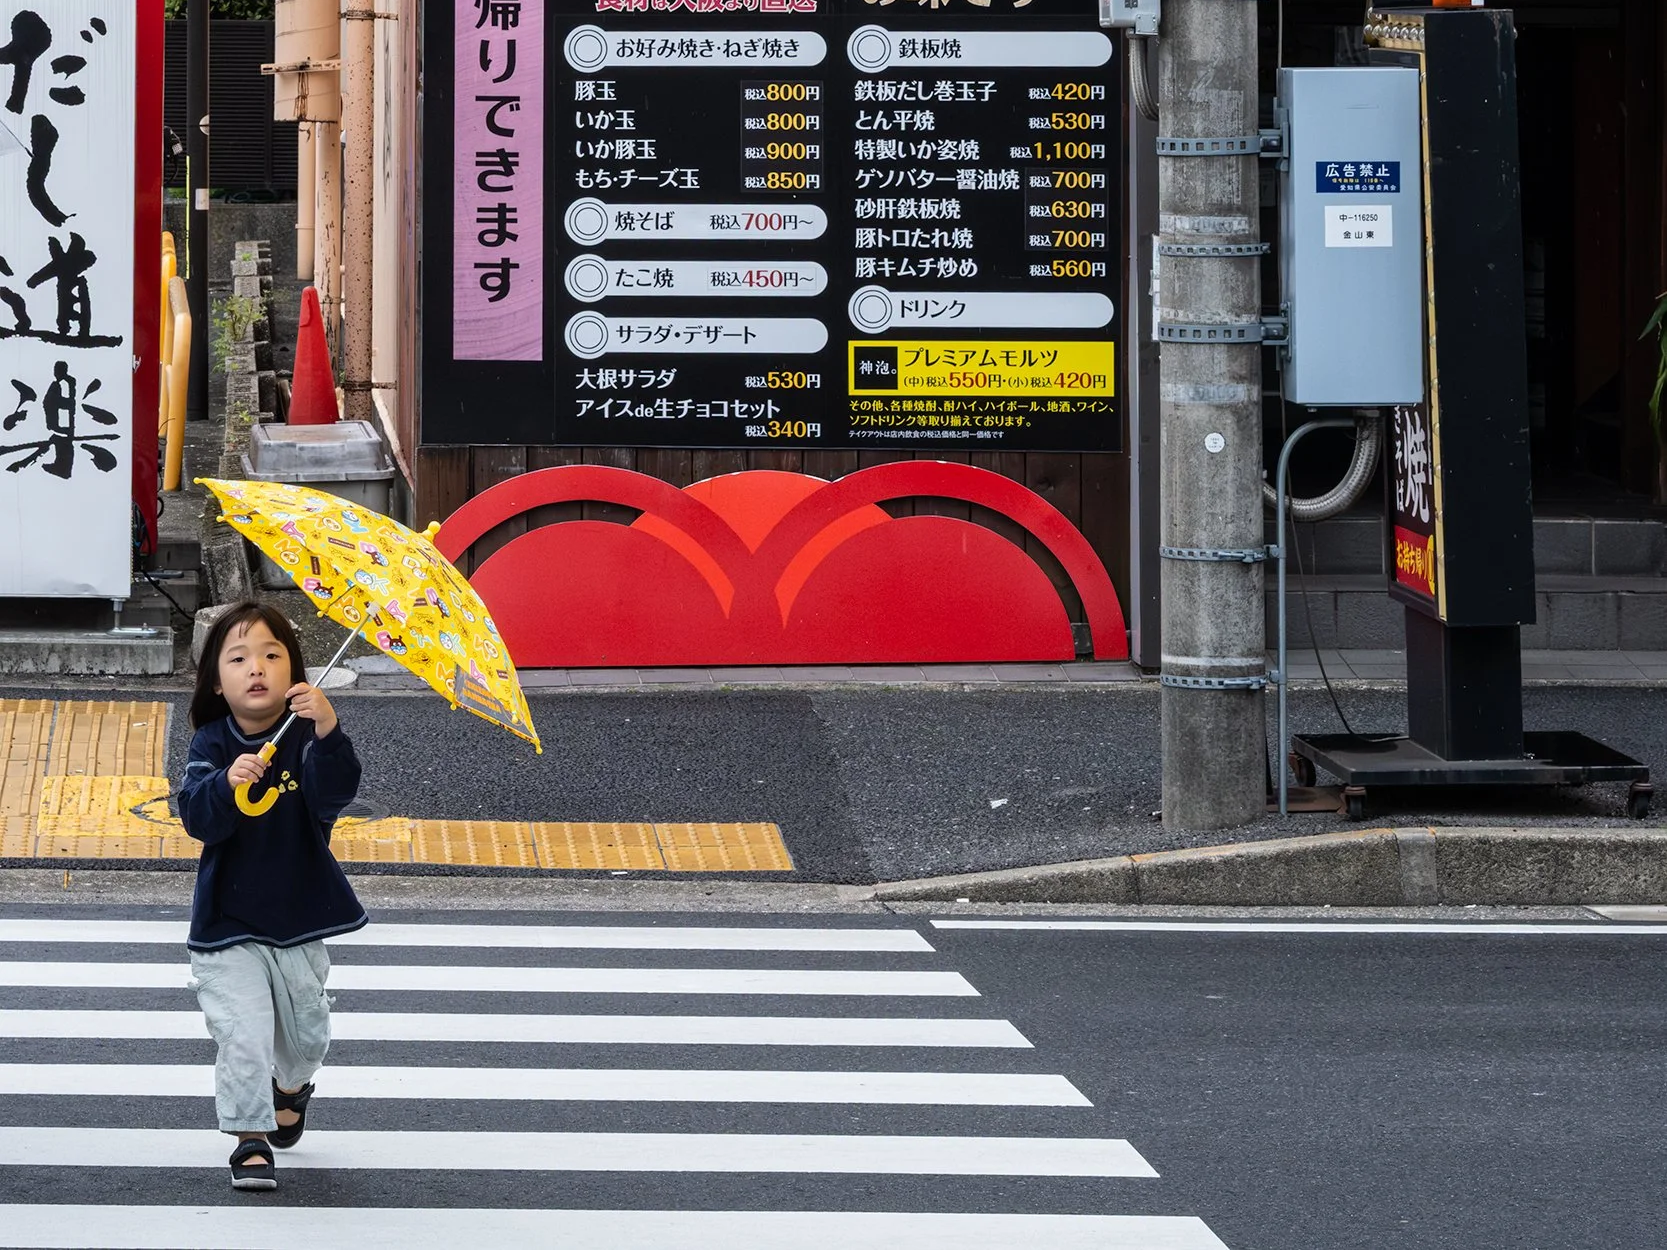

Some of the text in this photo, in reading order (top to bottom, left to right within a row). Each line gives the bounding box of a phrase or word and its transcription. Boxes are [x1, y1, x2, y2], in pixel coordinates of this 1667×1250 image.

[616, 38, 800, 58] お好み焼き・ねぎ焼き
[899, 38, 961, 58] 鉄板焼
[574, 80, 820, 101] 豚玉 税込800円
[854, 80, 1105, 102] 鉄板だし巻玉子 税込420円
[576, 110, 820, 130] いか玉 税込800円
[855, 110, 1105, 131] とん平焼 税込530円
[576, 139, 820, 160] いか豚玉 税込900円
[854, 139, 1105, 160] 特製いか姿焼 税込1,100円
[575, 169, 820, 189] もち・チーズ玉 税込850円
[855, 169, 1105, 190] ゲソバター醤油焼 税込700円
[1325, 163, 1390, 177] 広告禁止
[855, 198, 1105, 219] 砂肝鉄板焼 税込630円
[615, 211, 813, 232] 焼そば 税込700円～
[0, 9, 124, 480] だし道楽
[855, 228, 1105, 249] 豚トロたれ焼 税込700円
[1343, 231, 1374, 239] 金山東
[855, 257, 1106, 278] 豚キムチ炒め 税込560円
[615, 268, 814, 288] たこ焼 税込450円～
[900, 300, 966, 319] ドリンク
[616, 325, 756, 345] サラダ・デザート
[905, 347, 1058, 368] プレミアムモルツ
[859, 361, 897, 375] 神泡。
[576, 369, 821, 390] 大根サラダ 税込530円
[576, 398, 781, 419] アイスde生チョコセット
[849, 401, 1114, 413] その他、各種焼酎、酎ハイ、ハイボール、地酒、ワイン、
[745, 421, 821, 438] 税込340円
[849, 416, 1032, 427] ソフトドリンク等取り揃えております。
[849, 431, 1004, 439] テイクアウトは店内飲食の税込価格と同一価格です
